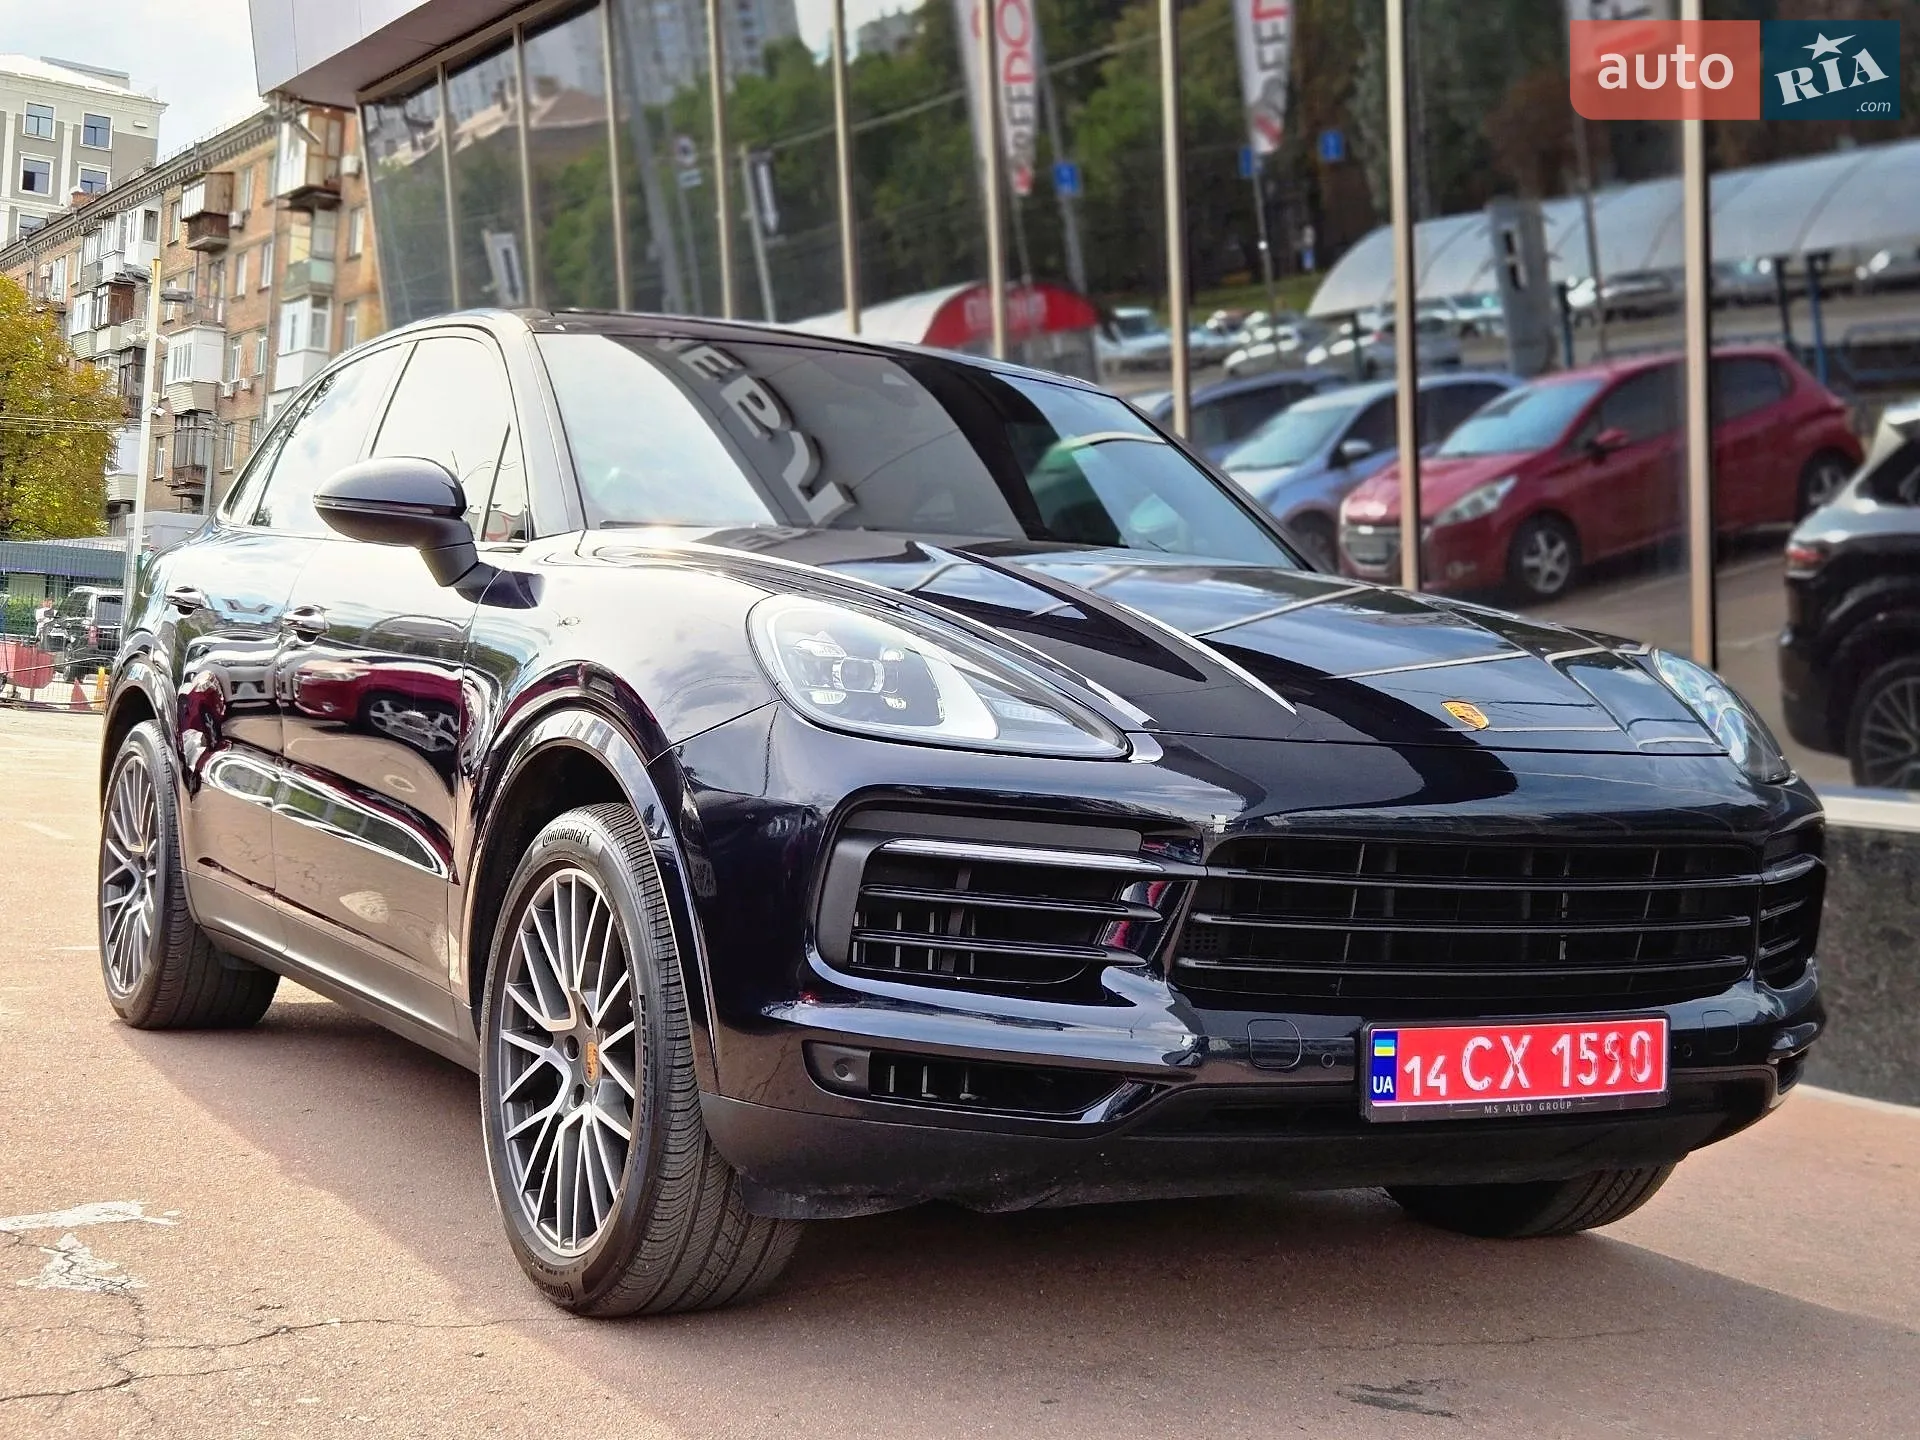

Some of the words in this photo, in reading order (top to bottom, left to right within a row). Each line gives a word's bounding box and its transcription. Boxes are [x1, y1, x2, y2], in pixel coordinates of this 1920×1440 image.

[542, 826, 587, 848] Continental
[1403, 1055, 1447, 1097] 14
[1461, 1034, 1532, 1091] CX
[1551, 1030, 1653, 1088] 1590
[1372, 1075, 1394, 1094] UA
[1483, 1104, 1499, 1114] MS
[1505, 1103, 1532, 1113] AUTO
[1538, 1100, 1572, 1111] GROUP
